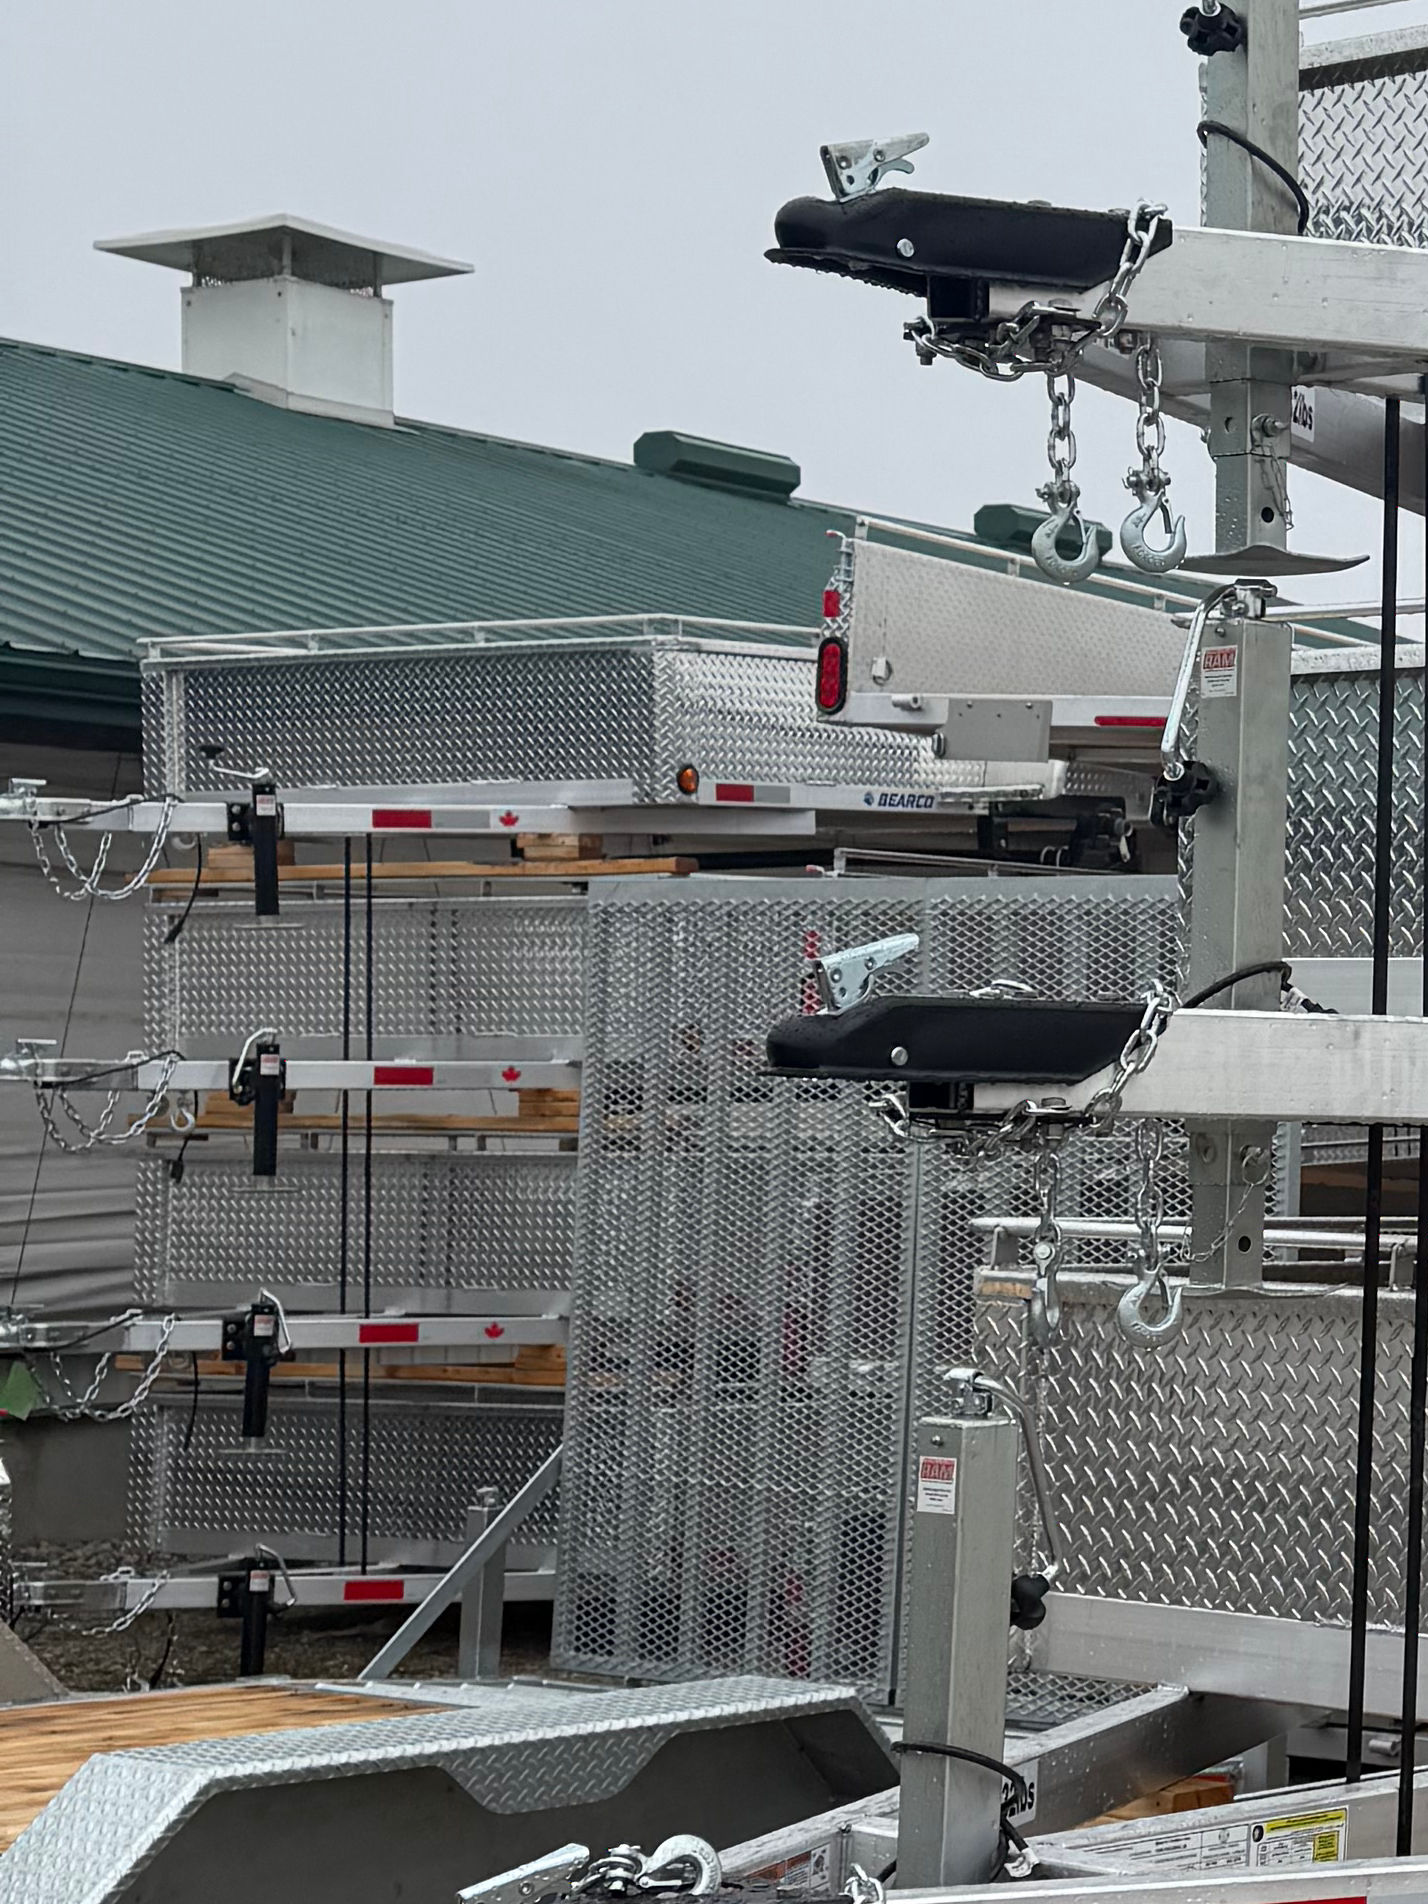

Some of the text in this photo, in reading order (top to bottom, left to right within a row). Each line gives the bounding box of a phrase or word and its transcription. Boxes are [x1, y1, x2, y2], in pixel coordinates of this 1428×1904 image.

[1292, 389, 1313, 431] 2lbs
[1204, 652, 1236, 669] RAM
[878, 792, 935, 809] BEARCO
[921, 1461, 955, 1481] RAM
